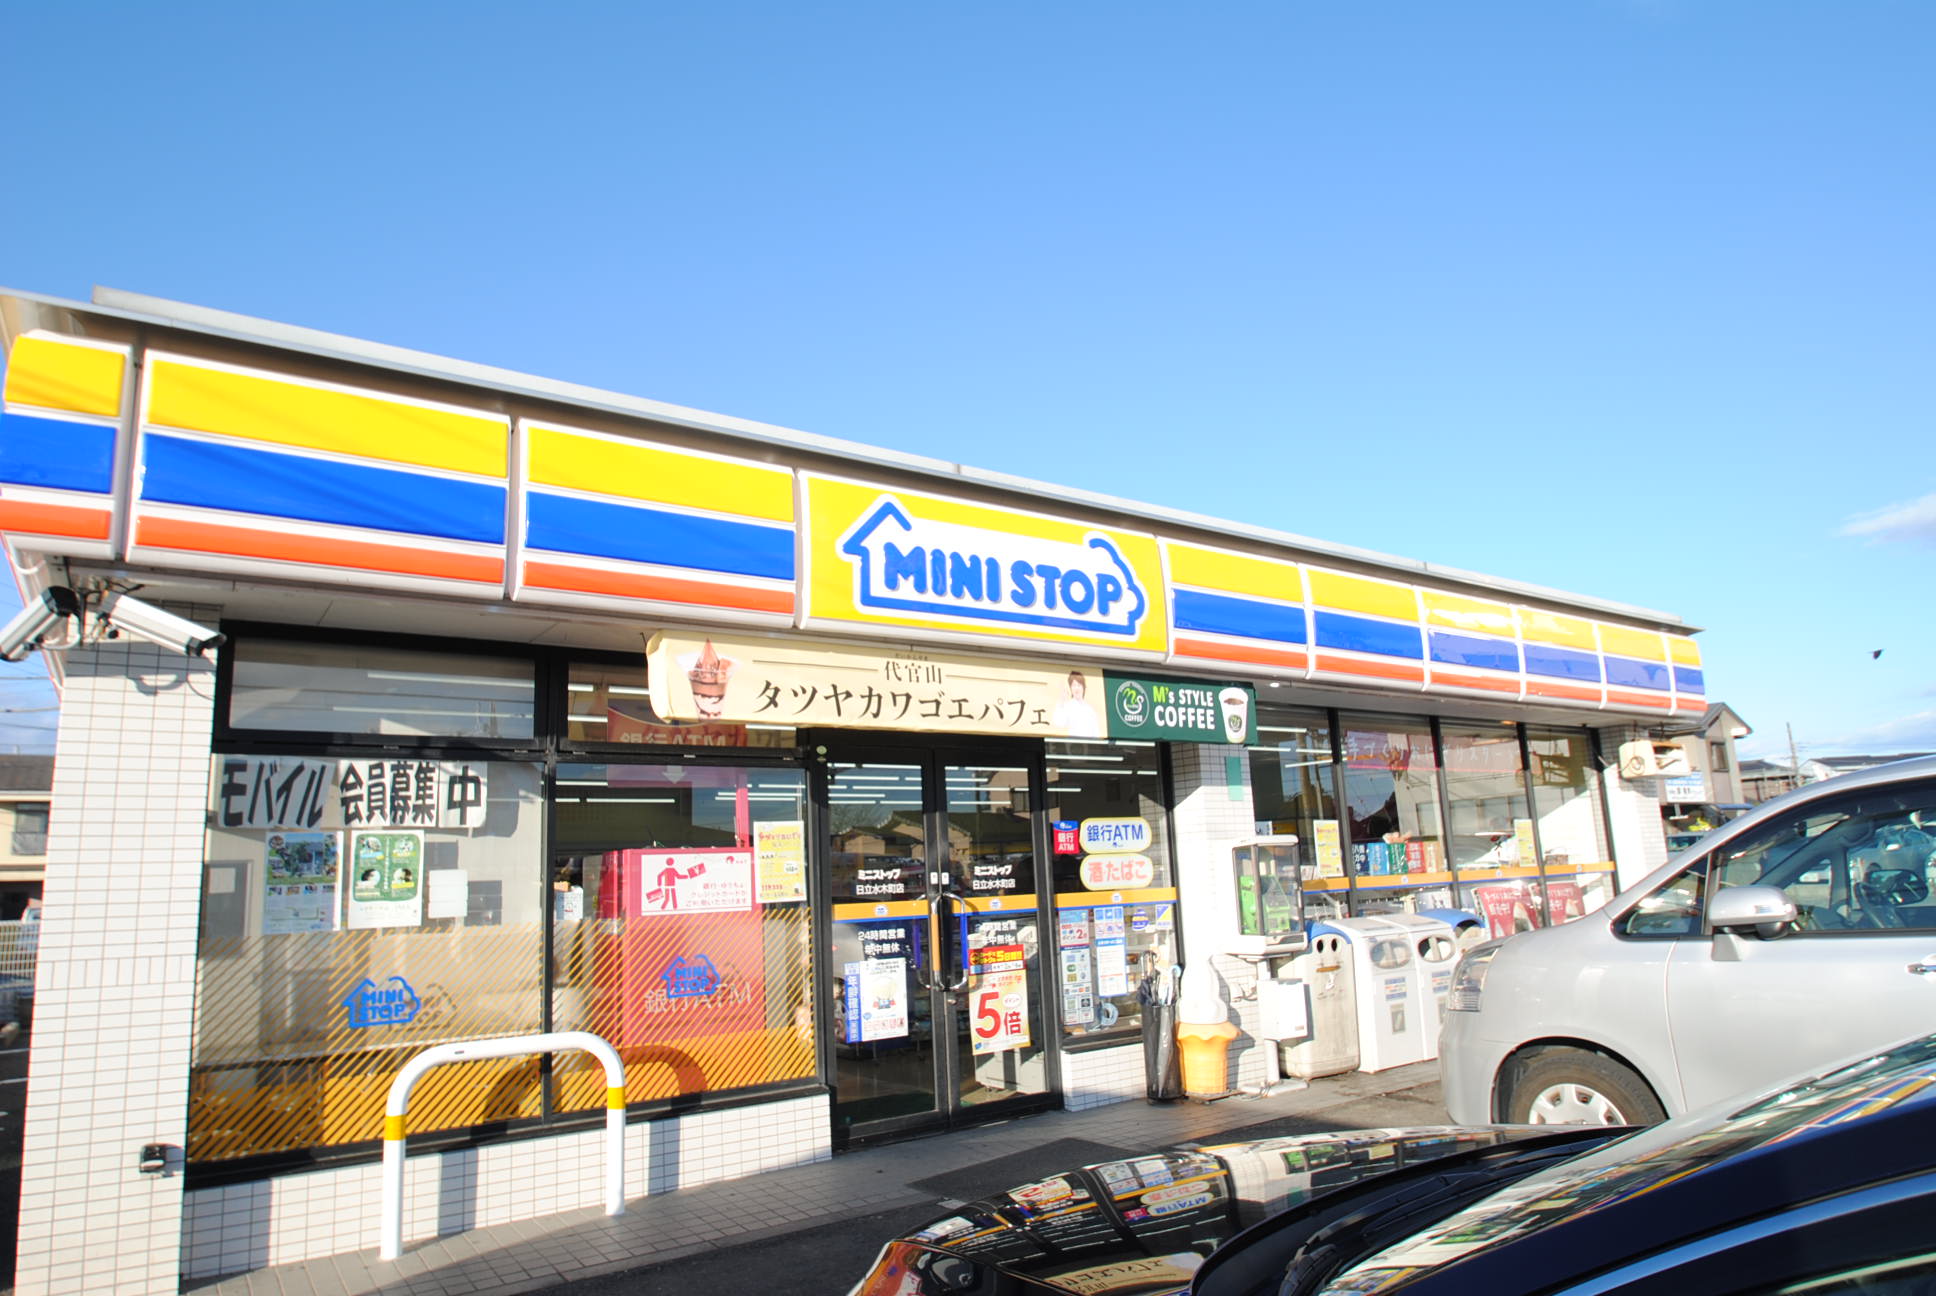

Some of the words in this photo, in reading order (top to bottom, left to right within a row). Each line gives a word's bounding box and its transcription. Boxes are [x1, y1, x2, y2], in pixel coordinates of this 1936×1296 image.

[883, 541, 1001, 603] MINI
[1010, 559, 1124, 616] STOP
[884, 660, 942, 685] 代官山
[753, 679, 1051, 727] タツヤカワゴエパフェ
[1152, 685, 1175, 704] M's
[1178, 688, 1215, 707] STYLE
[1154, 705, 1216, 730] COFFEE
[1086, 824, 1144, 842] 銀行ATM
[1058, 842, 1075, 852] ATM
[857, 868, 901, 881] ミニストップ
[974, 864, 1012, 877] ミニストップ
[855, 883, 905, 895] 日立水木町店
[972, 878, 1016, 890] 日立水木町店
[857, 928, 906, 942] 24時間営業
[675, 965, 709, 980] MINI
[673, 977, 711, 993] STOP
[360, 988, 404, 1006] MINI
[358, 1003, 407, 1022] STOP
[975, 991, 1022, 1039] 5倍
